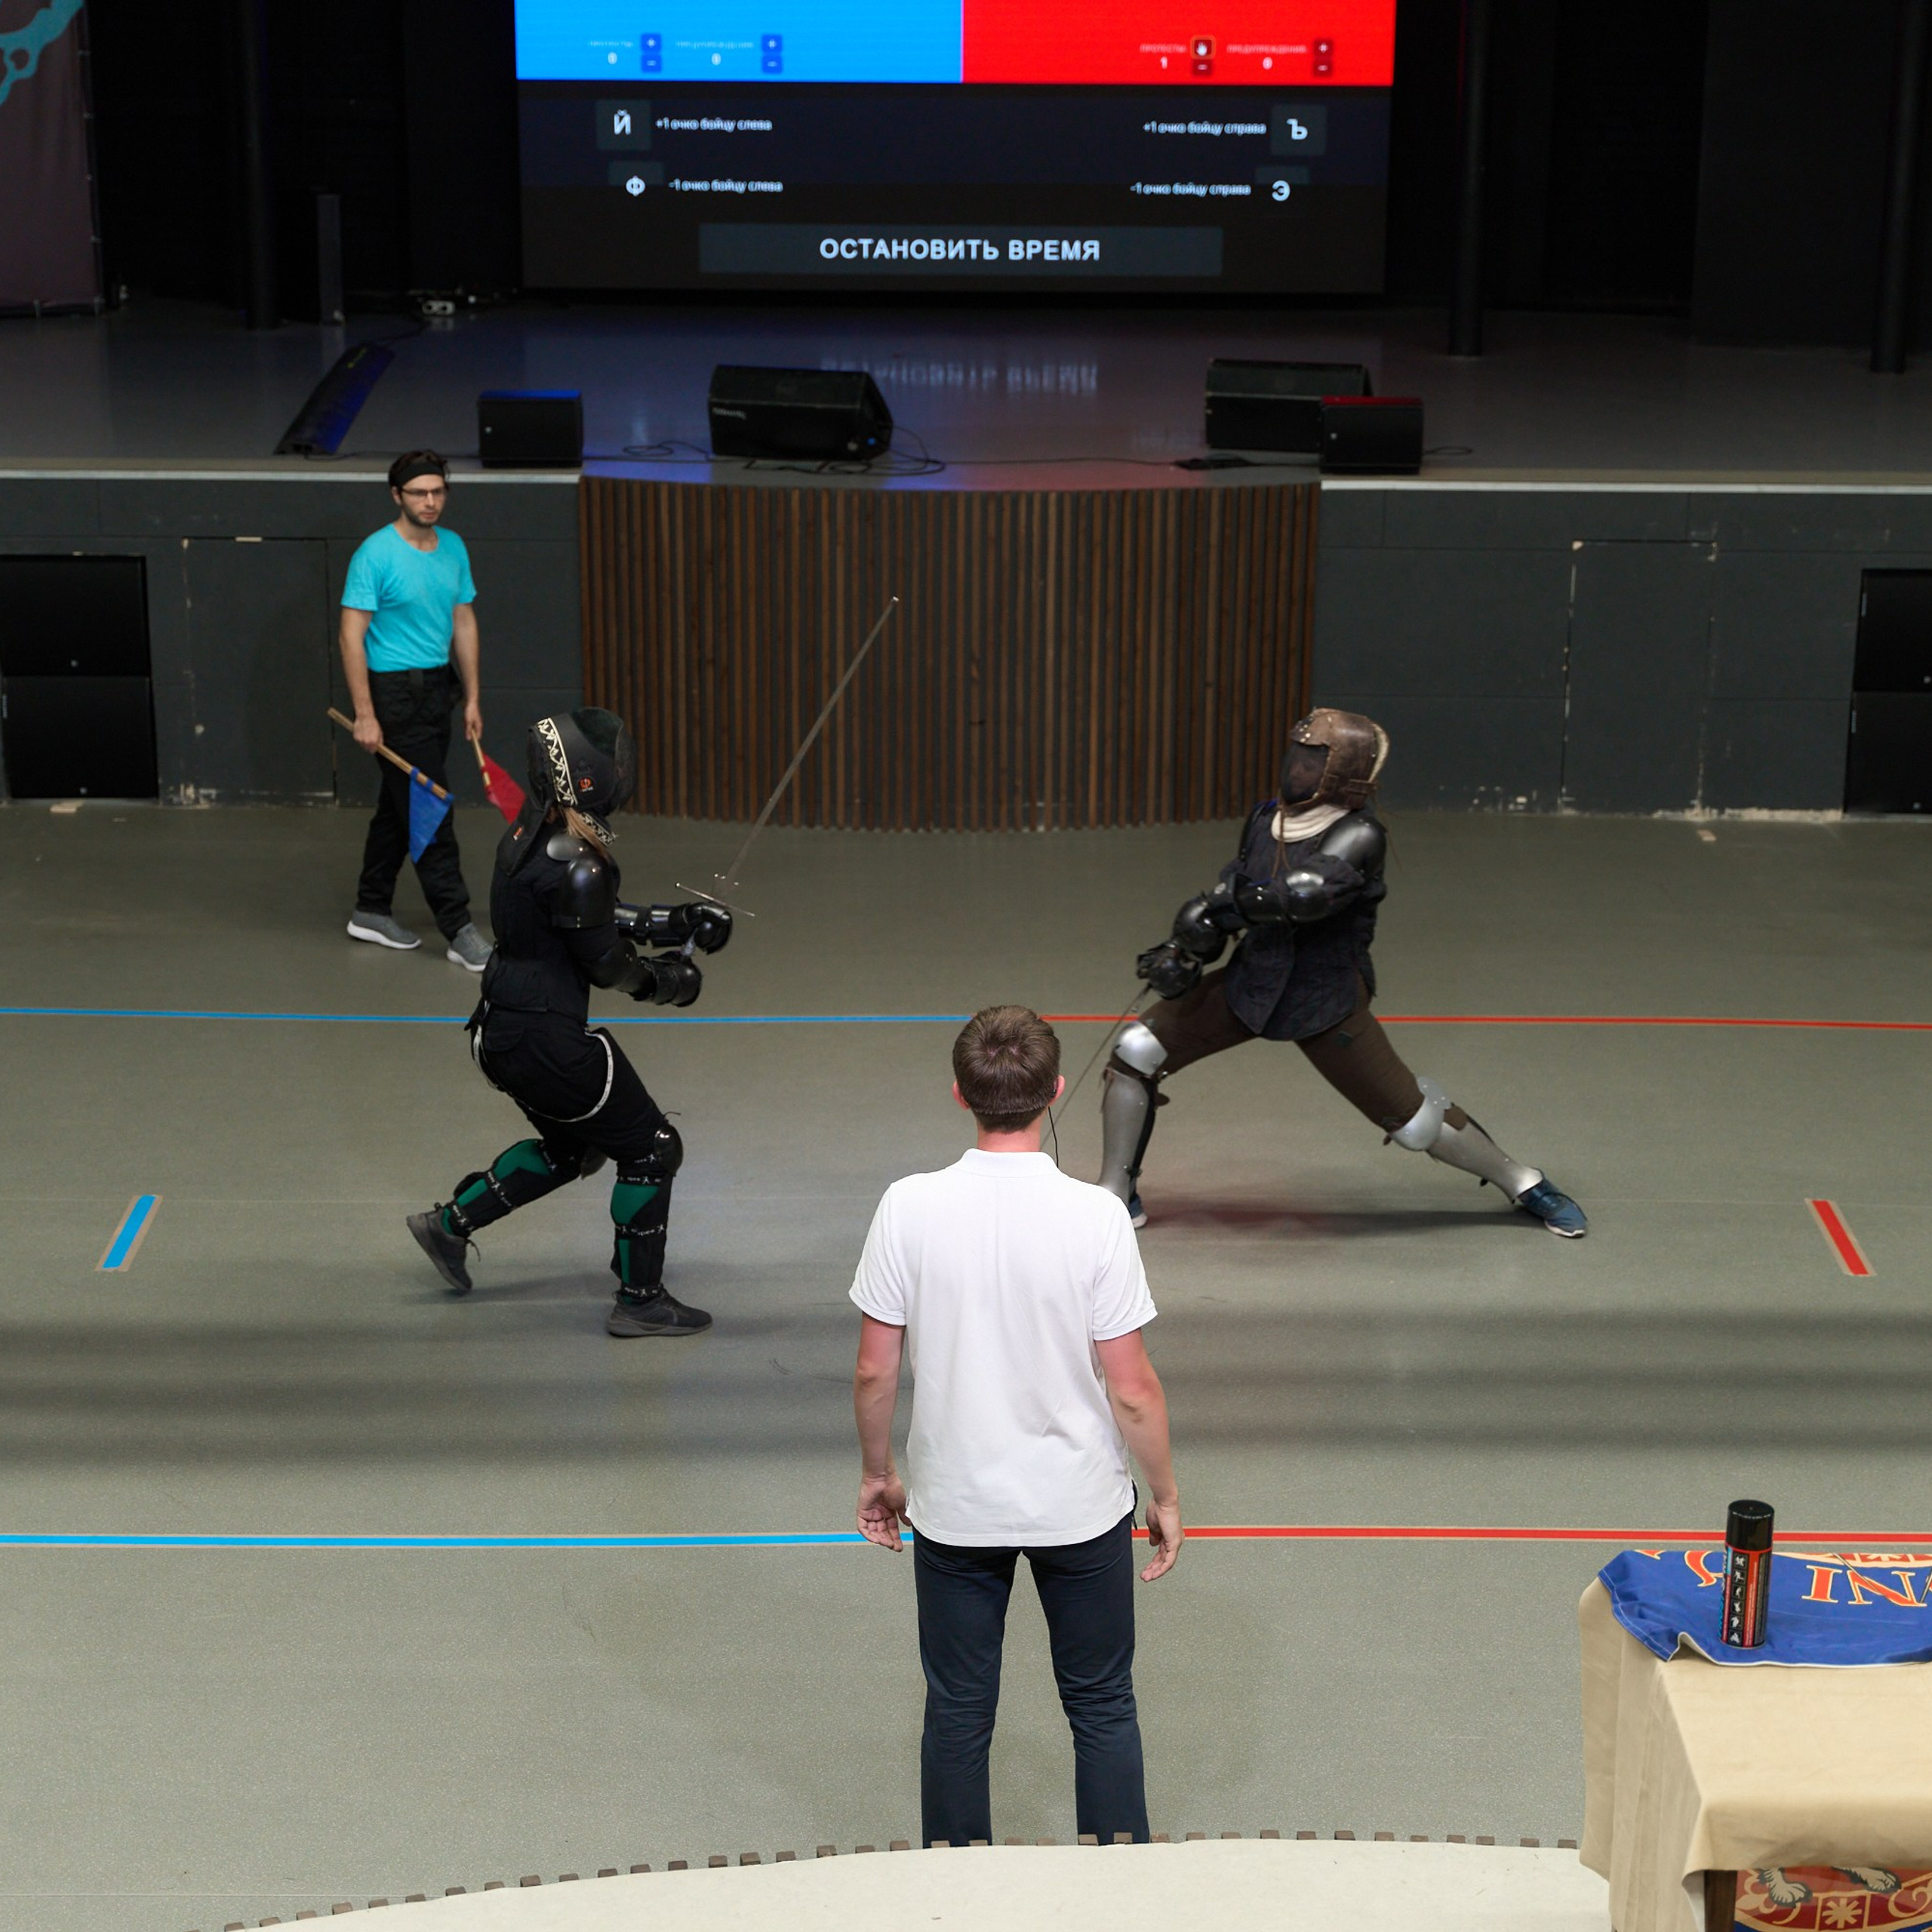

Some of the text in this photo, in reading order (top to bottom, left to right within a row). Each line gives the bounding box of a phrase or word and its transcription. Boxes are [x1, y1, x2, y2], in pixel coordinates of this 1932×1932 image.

[614, 109, 632, 135] Й
[1286, 118, 1309, 140] Ъ
[626, 175, 646, 197] Ф
[1272, 180, 1291, 202] Э
[819, 238, 1100, 261] ОСТАНОВИТЬ ВРЕМЯ
